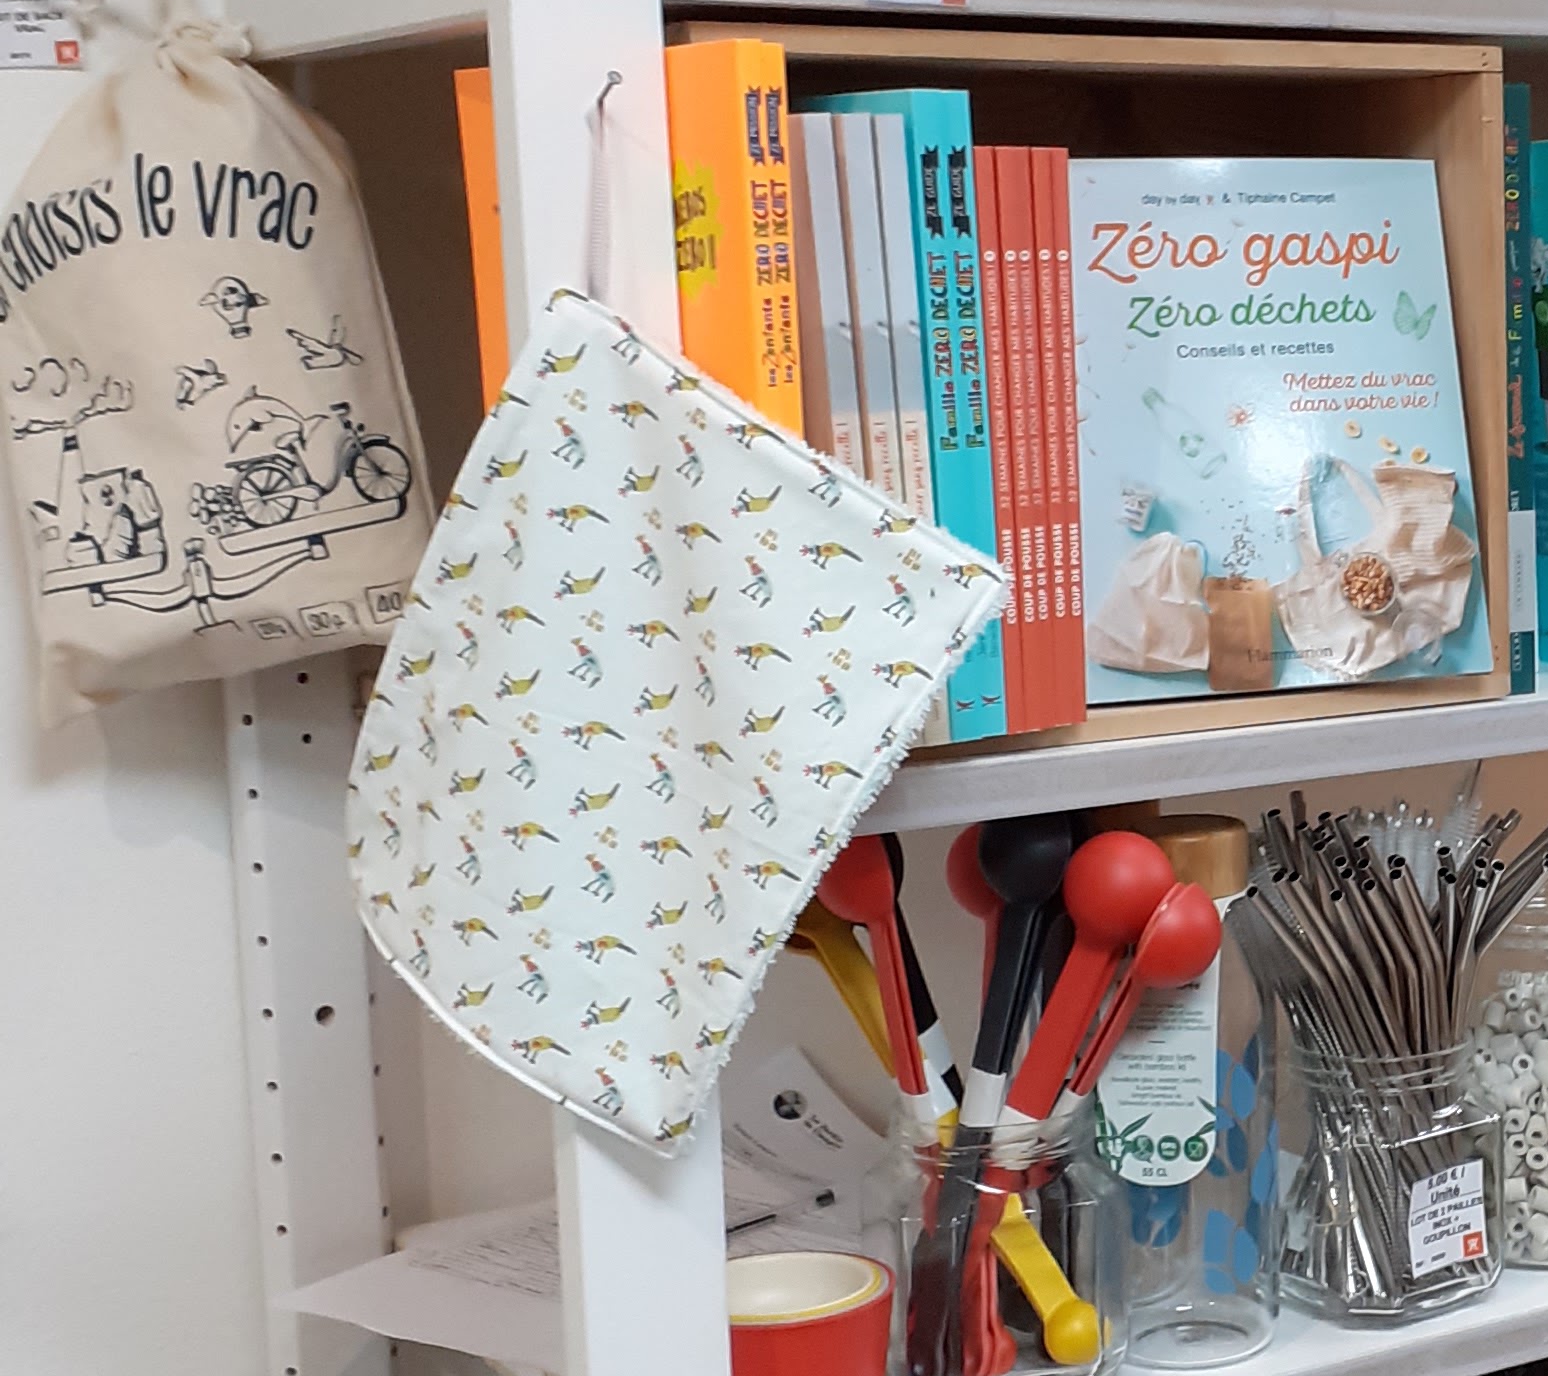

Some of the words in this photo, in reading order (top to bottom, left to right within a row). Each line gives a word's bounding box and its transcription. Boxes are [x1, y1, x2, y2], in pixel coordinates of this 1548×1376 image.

[134, 152, 175, 238] le
[193, 160, 318, 250] vrac
[1141, 194, 1162, 206] day
[1180, 194, 1200, 206] day
[1222, 193, 1231, 204] &
[1237, 192, 1287, 206] Tiphaine
[1087, 221, 1227, 284] Zéro
[1243, 220, 1400, 286] gaspi
[926, 252, 949, 320] DECHET
[953, 251, 977, 319] DECHET
[1127, 296, 1224, 338] Zéro
[1230, 293, 1376, 326] déchets
[933, 327, 953, 378] ZERO
[960, 326, 980, 376] ZERO
[1176, 343, 1246, 359] Conseils
[1250, 343, 1266, 357] et
[1271, 341, 1335, 357] recettes
[1283, 372, 1357, 392] Mettez
[1361, 370, 1386, 388] du
[1391, 372, 1436, 387] vrac
[1290, 393, 1341, 413] dans
[1345, 394, 1399, 410] votre
[1400, 392, 1430, 409] vie
[1069, 523, 1080, 565] POUSSE
[1070, 586, 1081, 616] COUP
[1431, 1184, 1460, 1203] Unité
